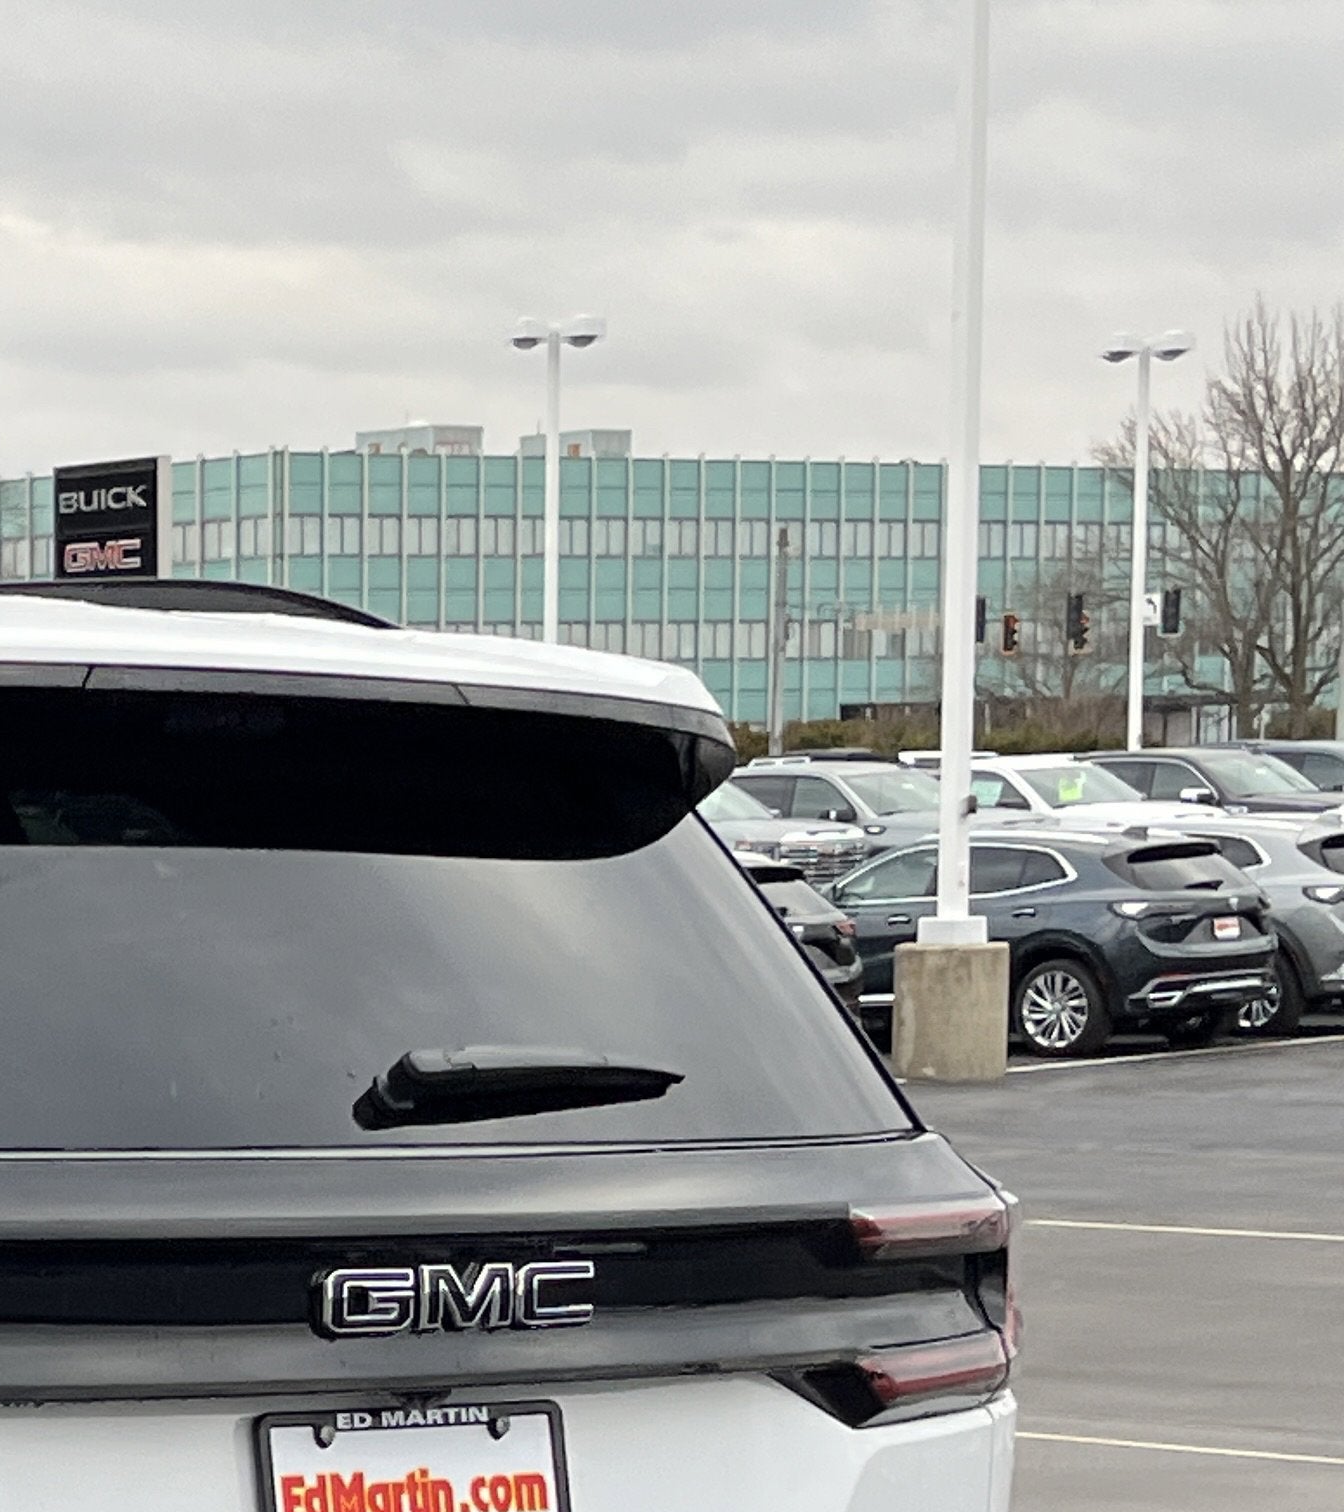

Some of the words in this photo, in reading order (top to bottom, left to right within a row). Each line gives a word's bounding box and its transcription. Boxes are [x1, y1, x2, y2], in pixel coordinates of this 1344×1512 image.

[58, 485, 148, 514] BUICK
[63, 538, 142, 573] GMC
[320, 1260, 595, 1334] GMC
[335, 1411, 372, 1430] ED
[381, 1405, 490, 1427] MARTIN
